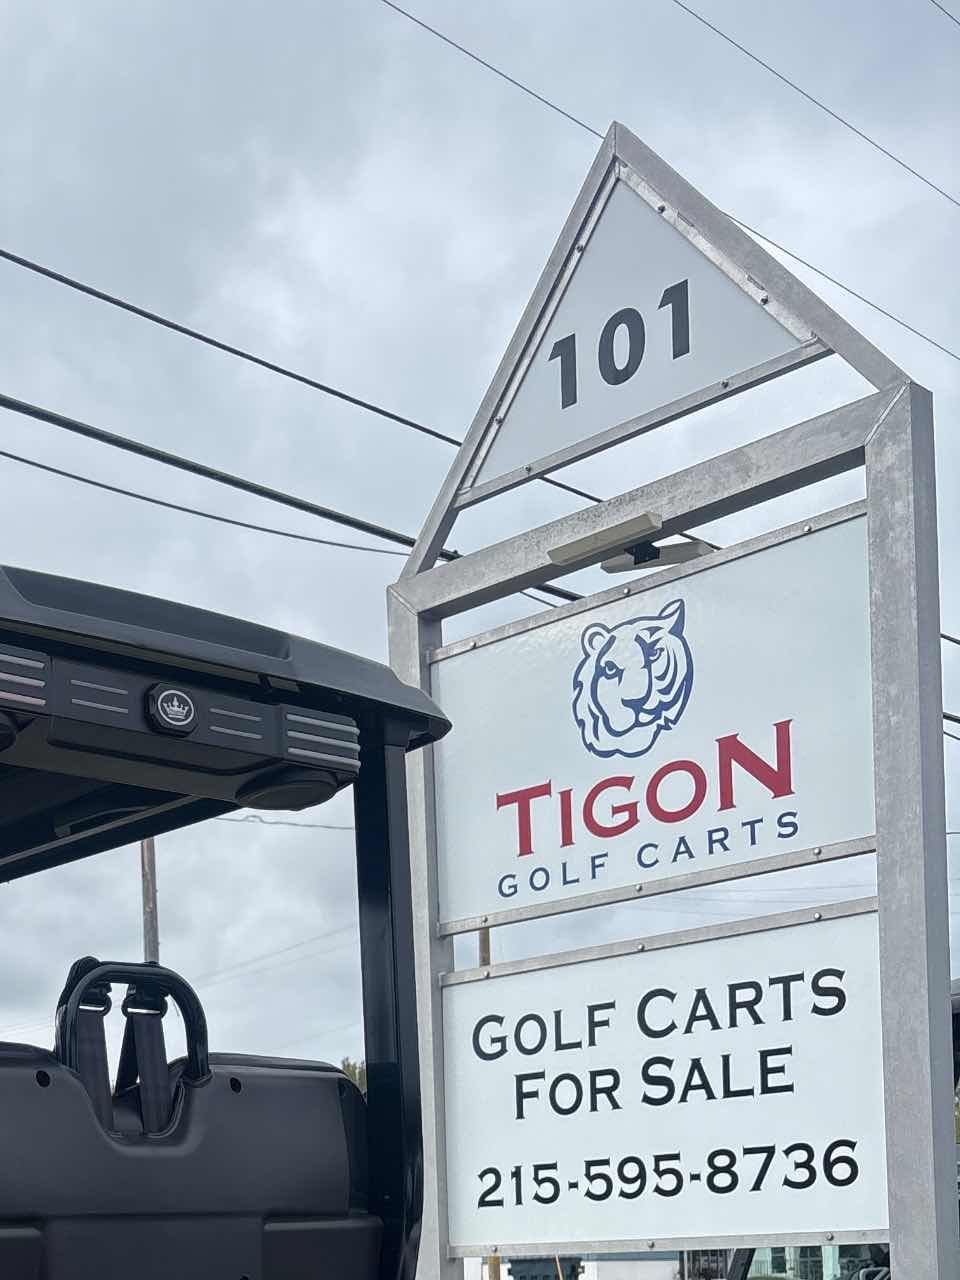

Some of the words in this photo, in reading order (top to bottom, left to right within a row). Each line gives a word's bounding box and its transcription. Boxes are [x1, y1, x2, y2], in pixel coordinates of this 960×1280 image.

[547, 278, 690, 410] 101
[495, 719, 795, 857] TIGON
[497, 852, 609, 899] GOLF
[636, 811, 799, 869] CARTS
[472, 1000, 616, 1061] GOLF
[637, 968, 847, 1039] CARTS
[514, 1069, 622, 1120] FOR
[641, 1044, 795, 1107] SALE
[477, 1139, 859, 1209] 215-595-8736
